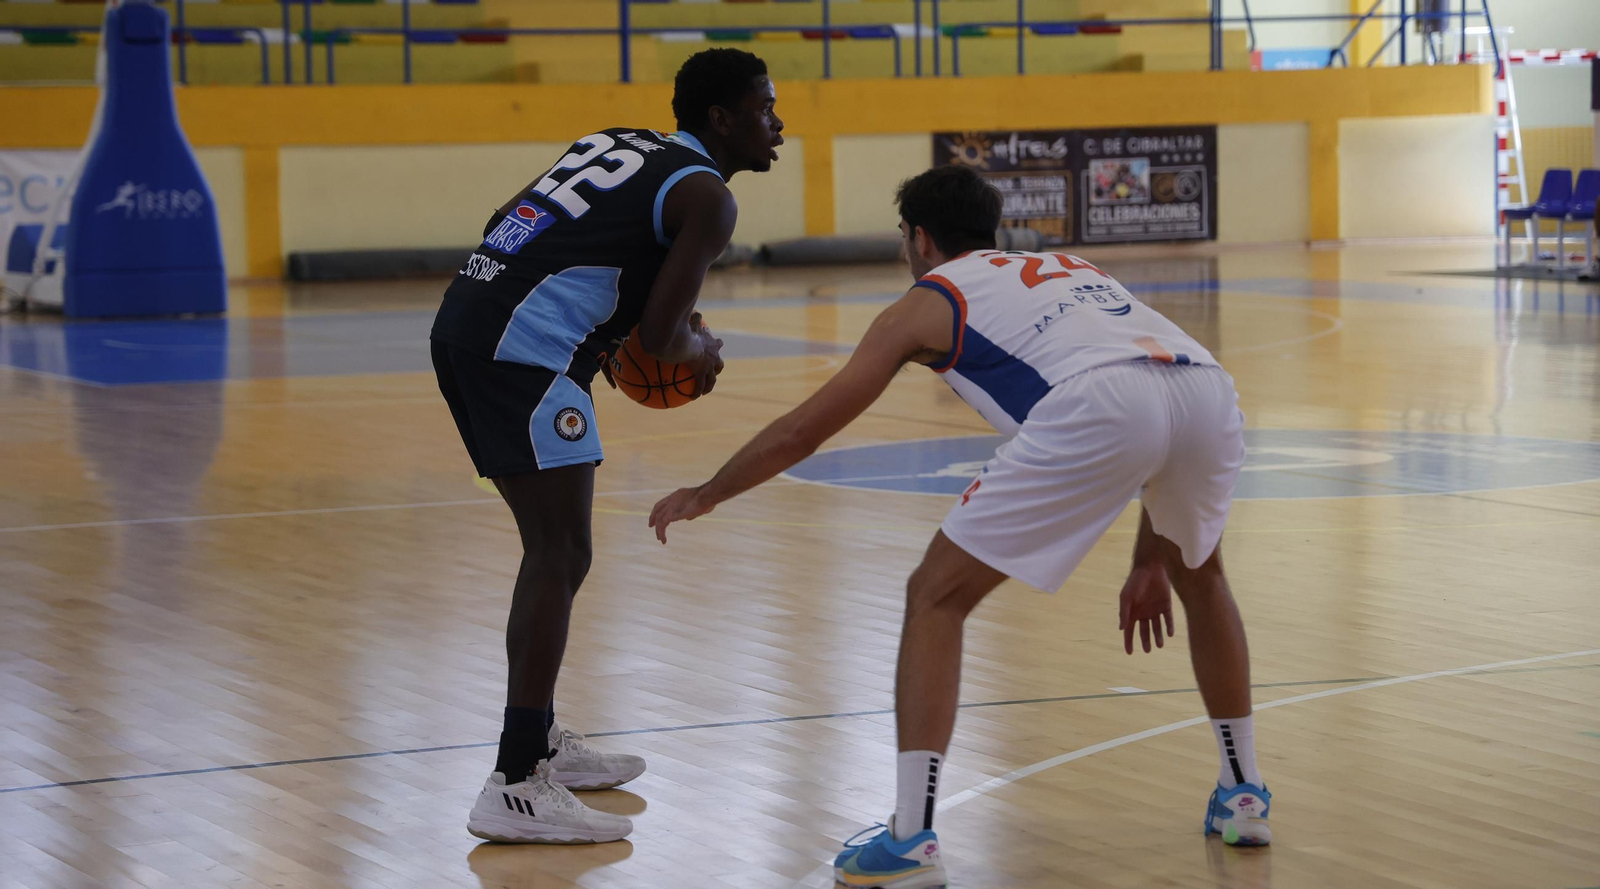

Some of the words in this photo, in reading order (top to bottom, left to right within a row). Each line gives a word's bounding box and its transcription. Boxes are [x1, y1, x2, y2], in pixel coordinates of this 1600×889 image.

[1102, 138, 1123, 154] DE
[1126, 135, 1204, 154] GIBRALTAR
[531, 133, 645, 220] 22
[1088, 202, 1201, 225] CELEBRACIONES
